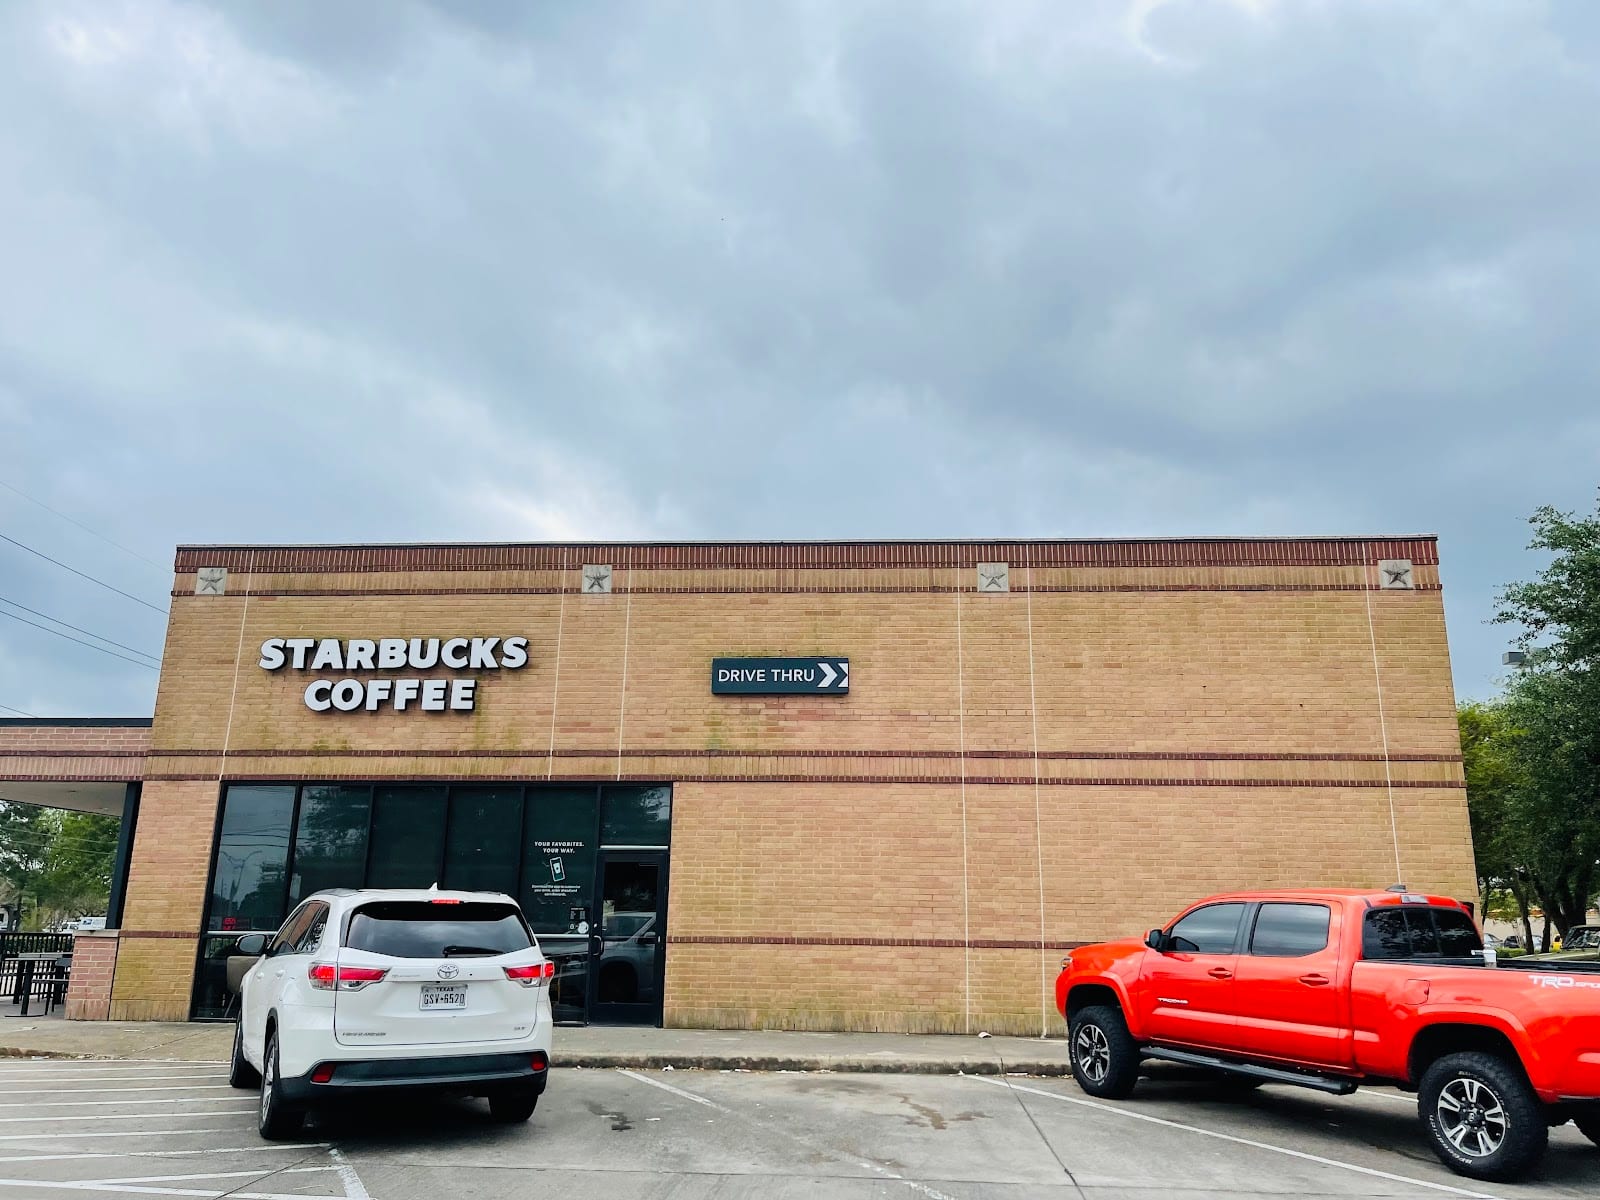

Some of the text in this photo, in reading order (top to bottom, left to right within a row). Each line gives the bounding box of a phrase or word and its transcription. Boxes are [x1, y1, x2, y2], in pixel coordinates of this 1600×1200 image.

[258, 636, 529, 670] STARBUCKS
[718, 669, 815, 682] DRIVE THRU
[304, 678, 476, 712] COFFEE
[1528, 974, 1575, 989] TRD
